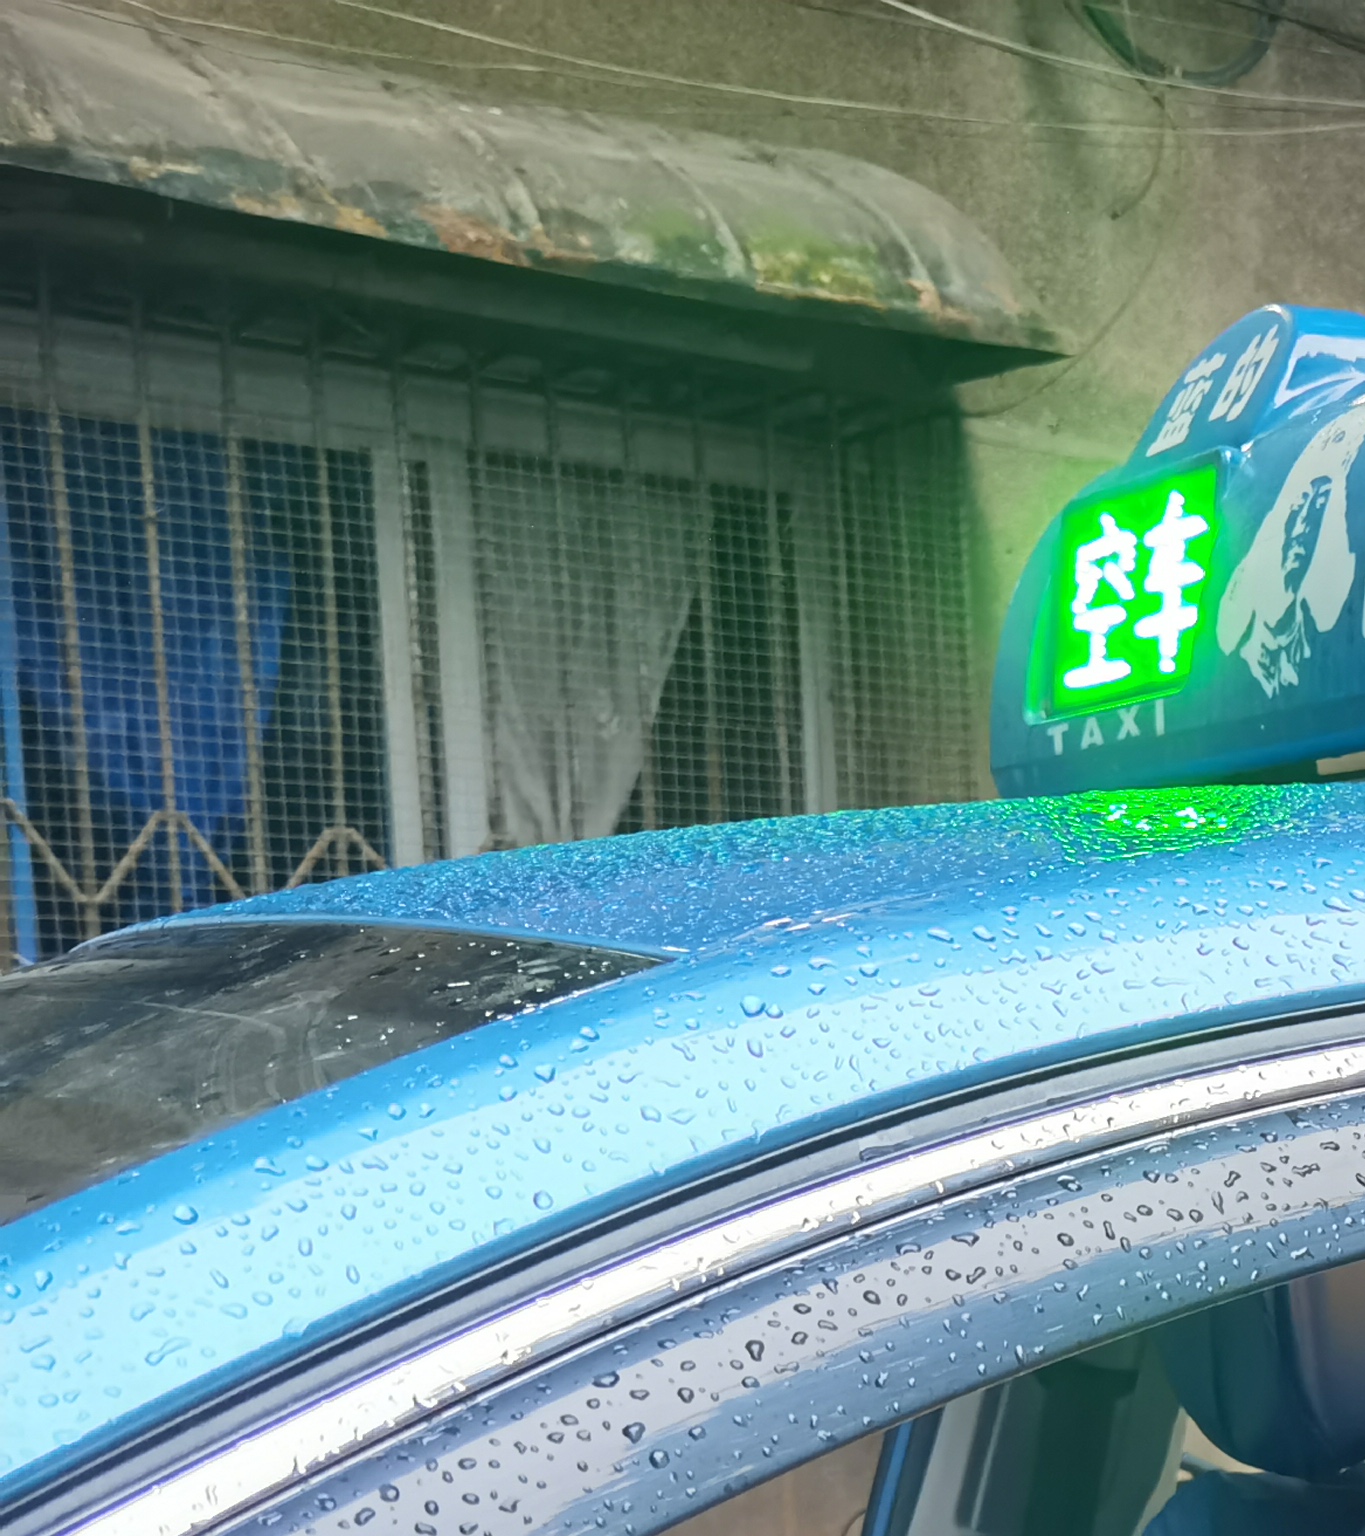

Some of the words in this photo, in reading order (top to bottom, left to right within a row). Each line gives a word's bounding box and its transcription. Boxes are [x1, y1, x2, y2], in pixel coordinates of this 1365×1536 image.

[1146, 324, 1280, 457] 蓝的
[1063, 489, 1211, 689] 空车
[1048, 700, 1166, 754] TAXI
